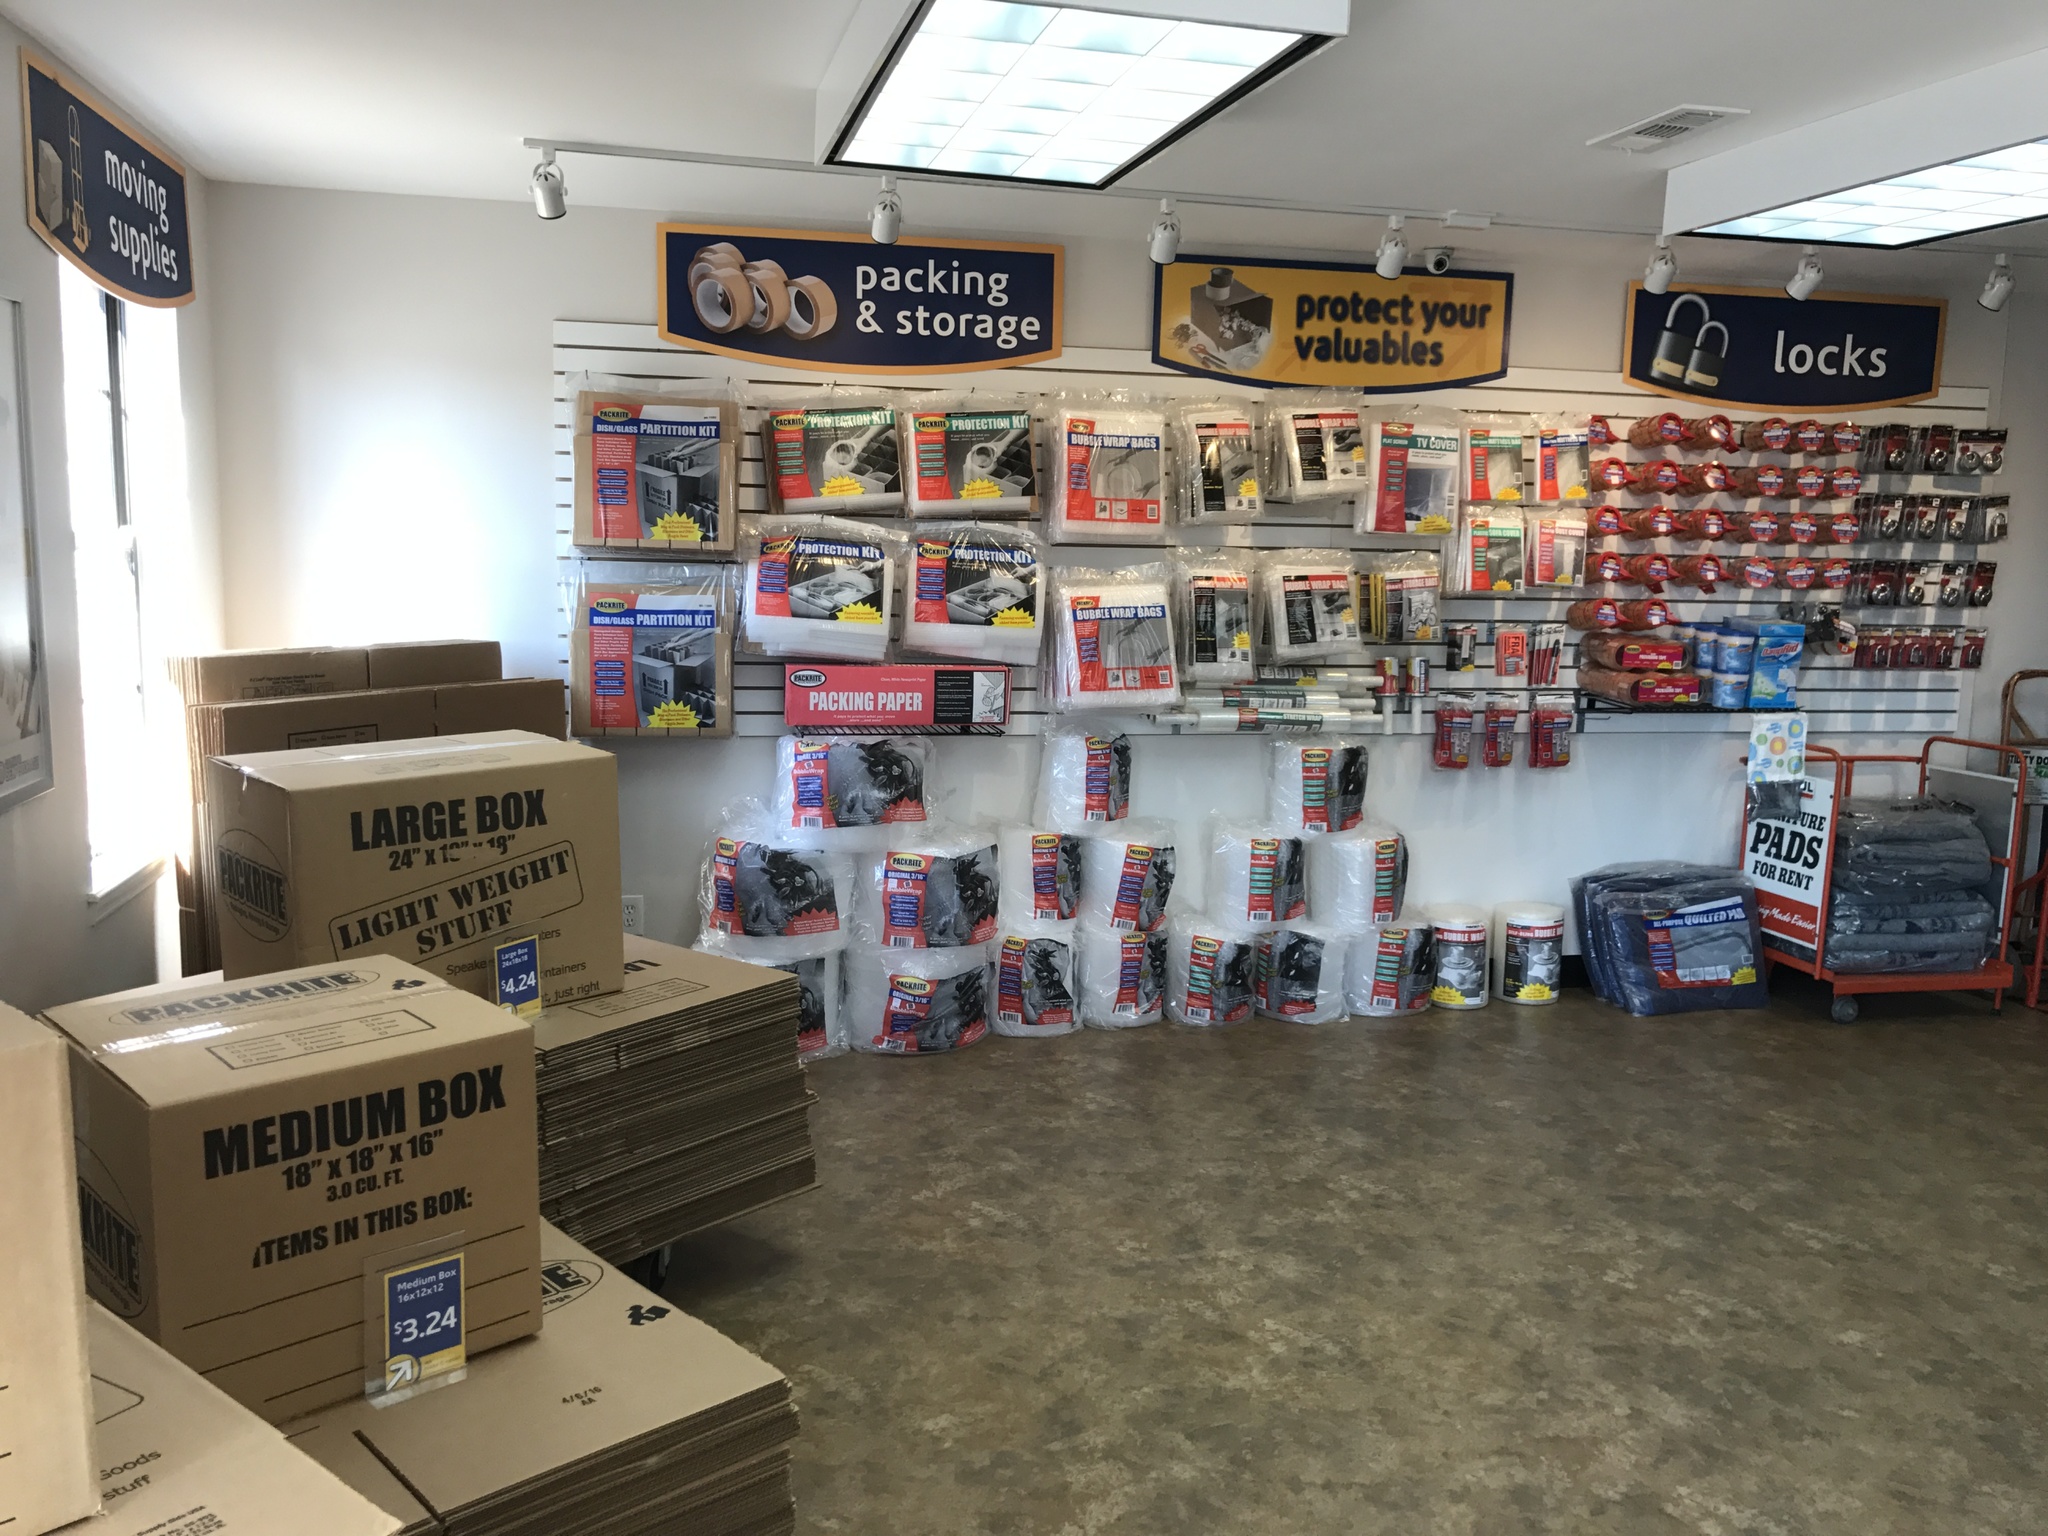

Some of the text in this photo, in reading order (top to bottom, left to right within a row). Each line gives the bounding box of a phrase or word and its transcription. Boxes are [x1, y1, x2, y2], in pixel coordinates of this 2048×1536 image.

[104, 149, 170, 234] moving
[109, 215, 179, 282] supplies
[856, 259, 1009, 307] packing
[1295, 291, 1492, 335] protect your
[855, 300, 1041, 350] & storage
[1294, 327, 1444, 367] valuables
[1774, 330, 1888, 378] locks
[600, 410, 629, 419] PACKRITE
[775, 417, 804, 426] PACKRITE
[810, 410, 892, 428] PROTECTION KIT
[918, 420, 947, 429] PACKRITE
[951, 415, 1029, 431] PROTECTION KIT
[596, 423, 717, 437] DISH/GLASS PARTITION KIT
[1103, 437, 1130, 448] WRAP
[1131, 437, 1157, 449] BAGS
[1416, 437, 1429, 448] TV
[1429, 438, 1457, 451] COVER
[799, 542, 860, 557] PROTECTION
[921, 546, 950, 555] PACKRITE
[954, 548, 1012, 562] PROTECTION
[596, 601, 625, 610] PACKRITE
[1076, 606, 1162, 621] BUBBLE WRAP BAGS
[593, 614, 712, 626] DISH/GLASS PARTITION KIT
[794, 674, 822, 682] PACKRITE
[809, 691, 874, 711] PACKING
[877, 692, 923, 711] PAPER
[1283, 713, 1306, 721] STRETCH
[350, 788, 548, 852] LARGE BOX
[1749, 821, 1824, 870] PADS
[388, 847, 421, 872] 24"
[892, 858, 922, 868] PACKRITE
[219, 848, 286, 921] PACKRITE
[887, 871, 911, 879] ORIGINAL
[1752, 860, 1814, 891] FOR RENT
[336, 893, 439, 950] LIGHT
[448, 849, 570, 910] WEIGHT
[1684, 911, 1727, 926] QUILTED
[1726, 907, 1746, 920] PAD
[1769, 907, 1791, 924] Made
[416, 899, 514, 957] STUFF
[1443, 931, 1469, 942] BUBBLE
[1534, 928, 1556, 938] BUBBLE
[501, 946, 529, 961] Large Box
[501, 970, 537, 995] $4.24
[554, 986, 575, 1003] just
[576, 980, 601, 999] right
[896, 980, 927, 991] PACKRITE
[128, 970, 361, 1022] PACKRITE
[892, 990, 930, 1004] ORIGINAL 3/16"
[203, 1064, 507, 1181] MEDIUM BOX
[281, 1158, 323, 1191] 18"
[346, 1143, 384, 1175] 18"
[406, 1128, 444, 1159] 16"
[326, 1168, 405, 1202] 3.0 CU. FT.
[334, 1215, 359, 1246] IN
[364, 1201, 418, 1236] THIS
[423, 1186, 473, 1221] BOX:
[396, 1268, 457, 1292] Medium Box
[397, 1282, 445, 1304] 16x12x12
[394, 1305, 458, 1343] $3.24
[102, 1474, 151, 1501] stuff
